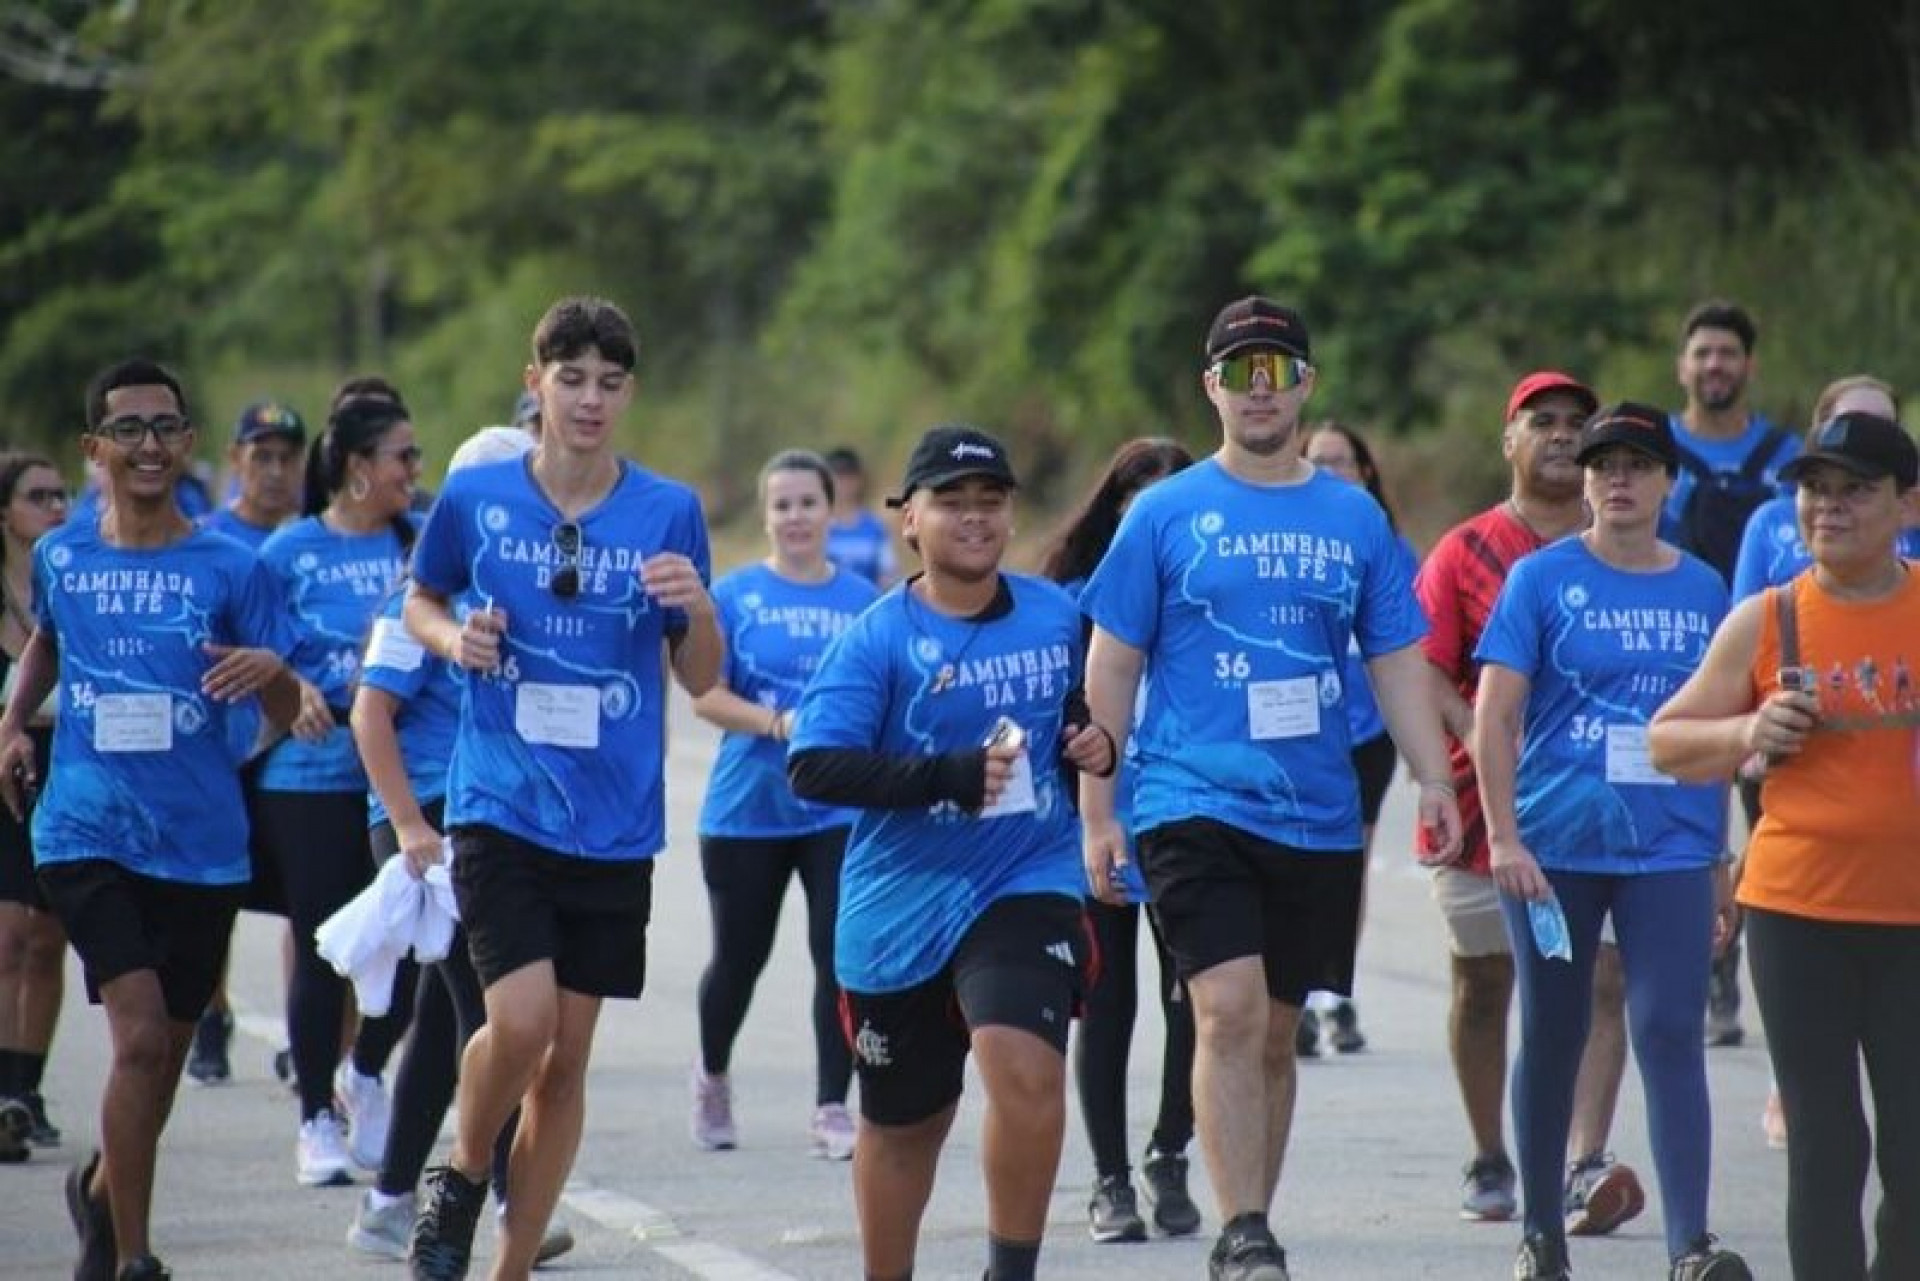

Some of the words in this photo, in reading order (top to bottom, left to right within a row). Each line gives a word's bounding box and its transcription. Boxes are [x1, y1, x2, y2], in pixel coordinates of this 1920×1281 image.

[500, 537, 642, 571] CAMIHADA
[1218, 532, 1354, 565] CAMINHADA
[537, 565, 551, 589] D
[1258, 556, 1288, 579] DA
[64, 570, 194, 596] CAMINHADA
[96, 592, 125, 615] DA
[1583, 608, 1709, 634] CAMINHADA
[1621, 631, 1650, 651] DA
[1215, 651, 1250, 679] 36
[70, 682, 96, 709] 36
[983, 680, 1016, 709] DA
[1569, 714, 1604, 742] 36
